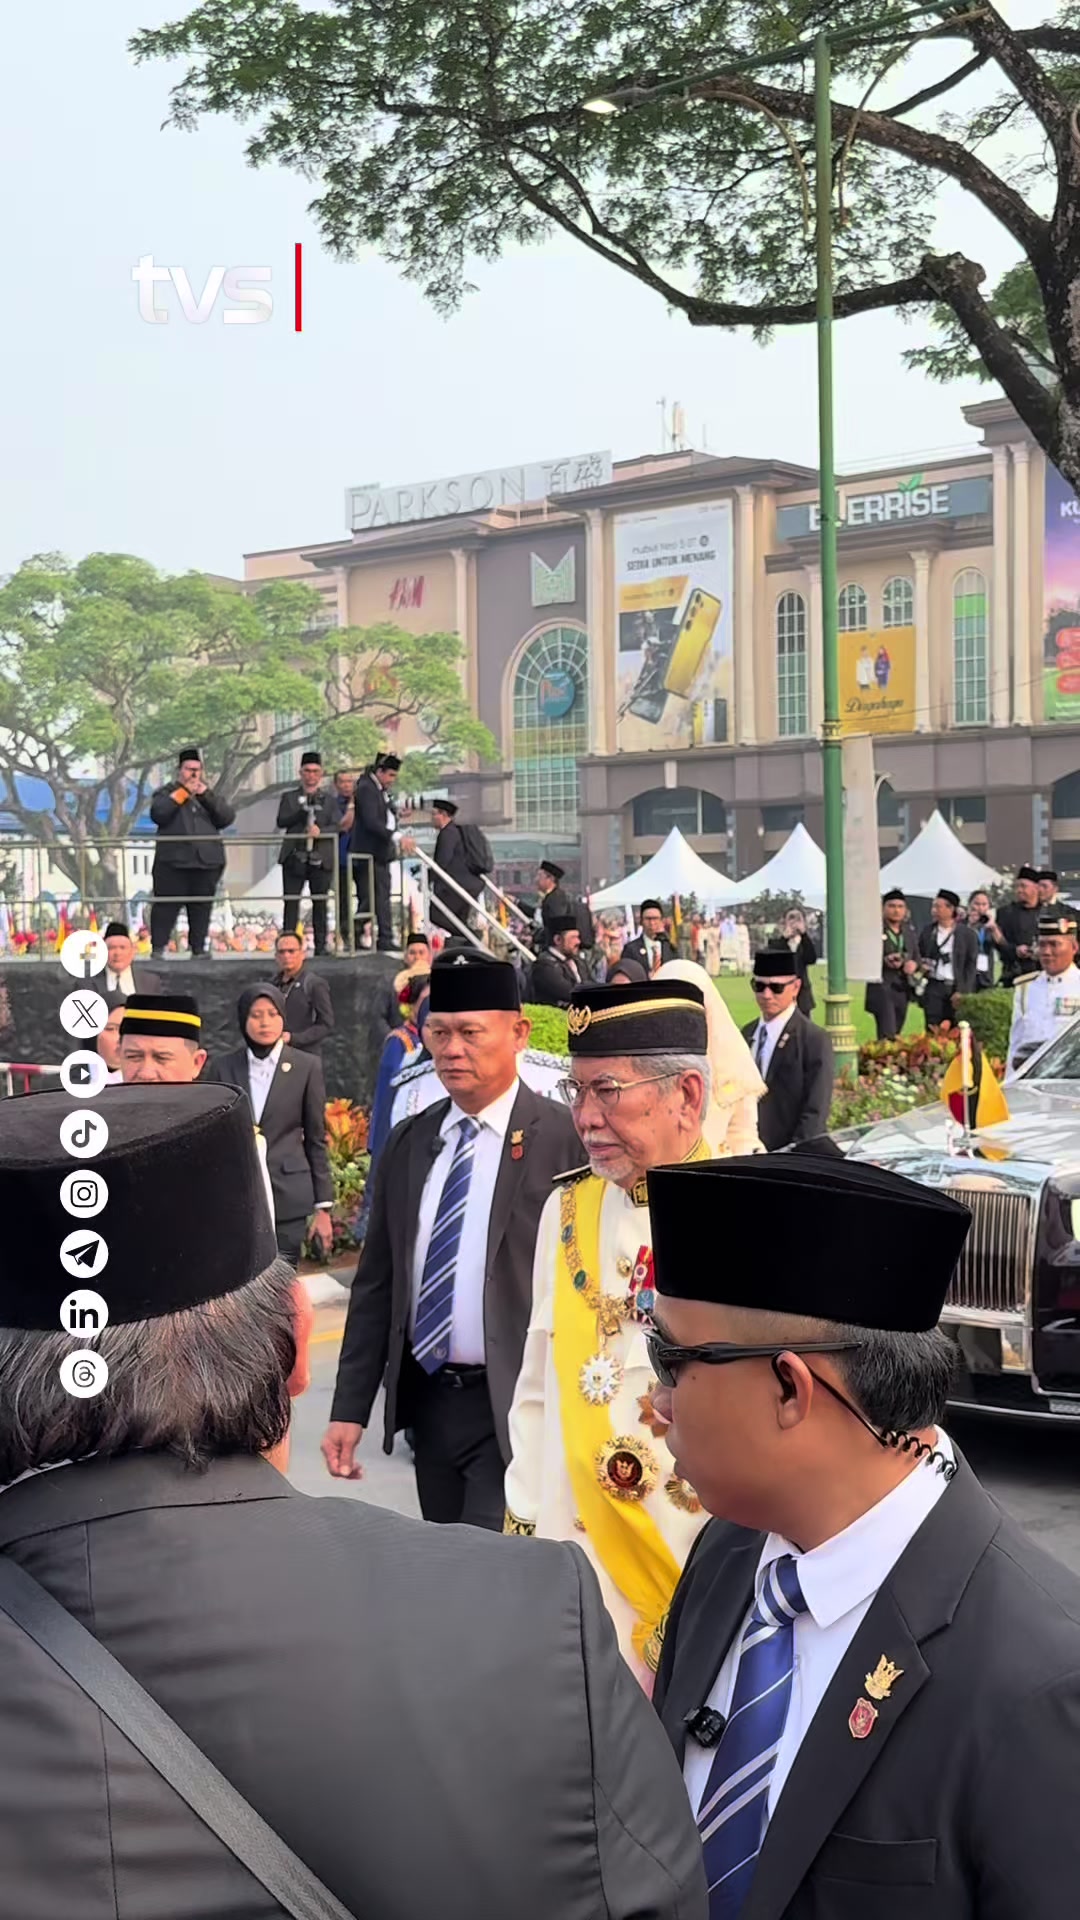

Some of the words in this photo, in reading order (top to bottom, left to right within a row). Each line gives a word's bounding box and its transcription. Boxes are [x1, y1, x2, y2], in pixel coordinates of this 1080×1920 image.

[351, 467, 526, 531] PARKSON
[809, 484, 950, 532] EERRISE
[389, 576, 425, 610] H&M
